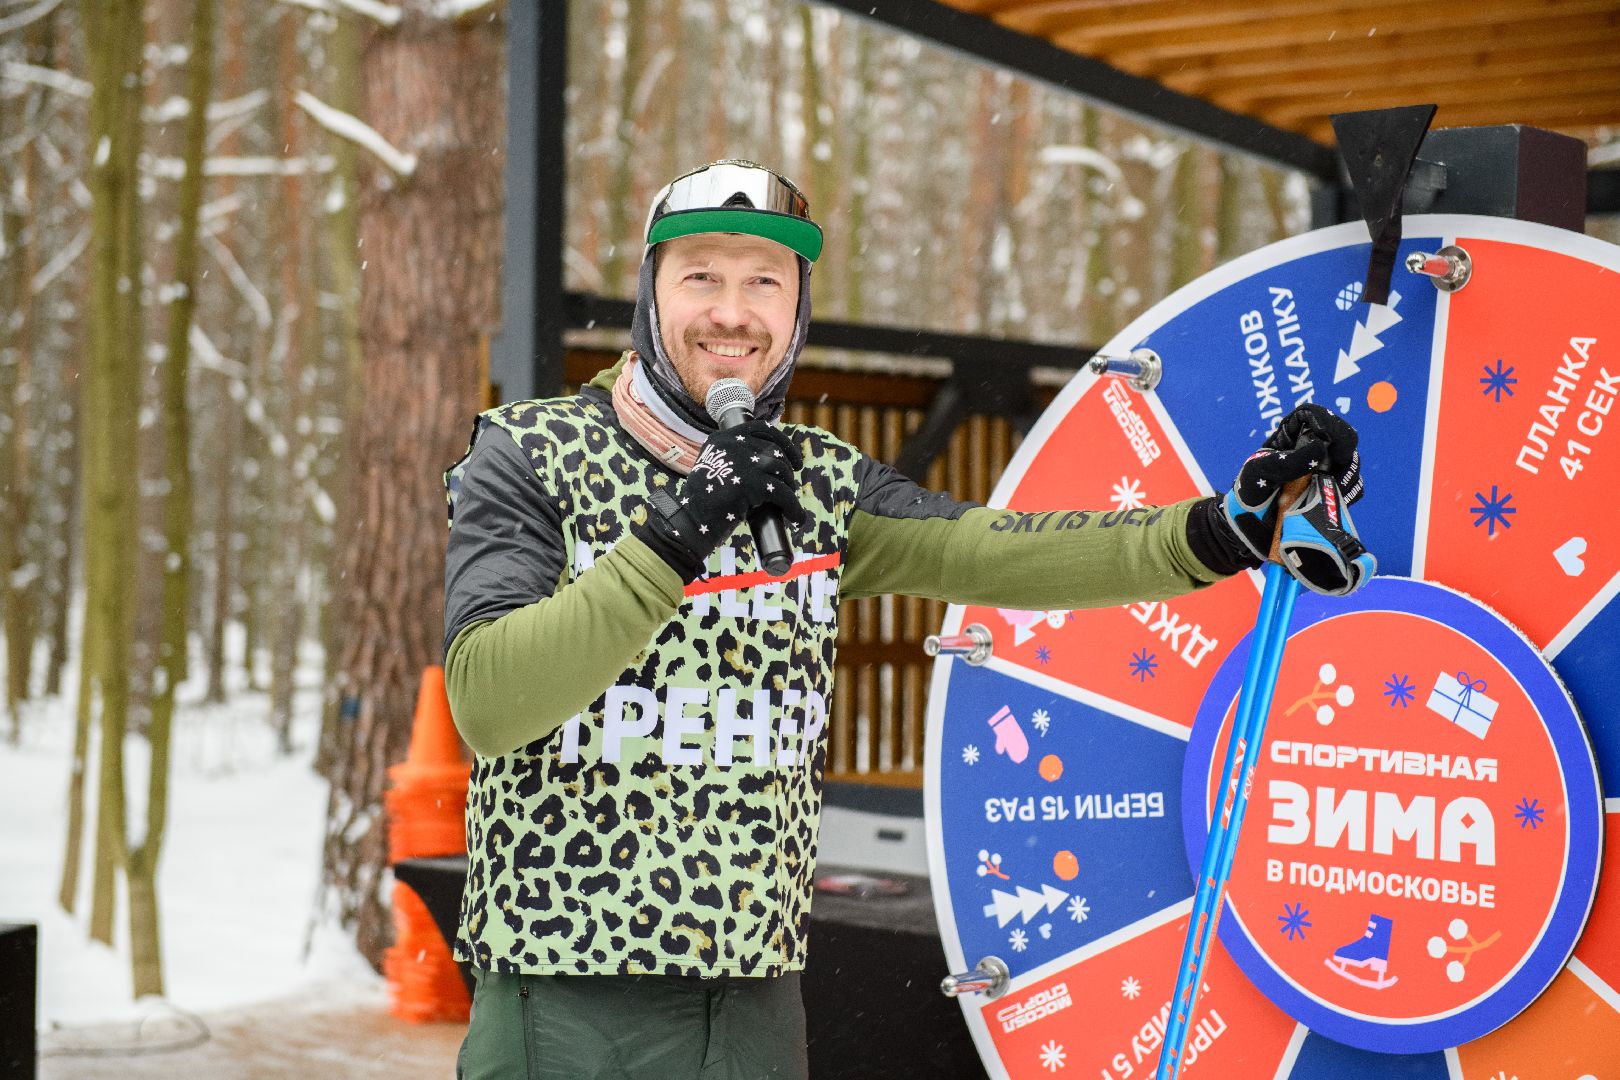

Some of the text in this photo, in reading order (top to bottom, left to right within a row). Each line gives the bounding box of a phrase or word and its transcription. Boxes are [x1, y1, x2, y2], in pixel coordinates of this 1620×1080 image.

[1240, 309, 1284, 438] ЫЖКОВ
[1268, 286, 1315, 409] АКАЛКУ
[1110, 379, 1161, 459] СПОРТ
[1515, 336, 1597, 475] ПЛАНКА
[1559, 366, 1620, 480] 41 СЕК
[1122, 601, 1219, 669] ДЖЕ
[1270, 739, 1498, 783] СПОРТИВНАЯ
[985, 791, 1165, 823] БЕРПИ 15 РАЗ
[1267, 779, 1496, 866] ЗИМА
[1266, 858, 1496, 909] В ПОДМОСКОВЬЕ
